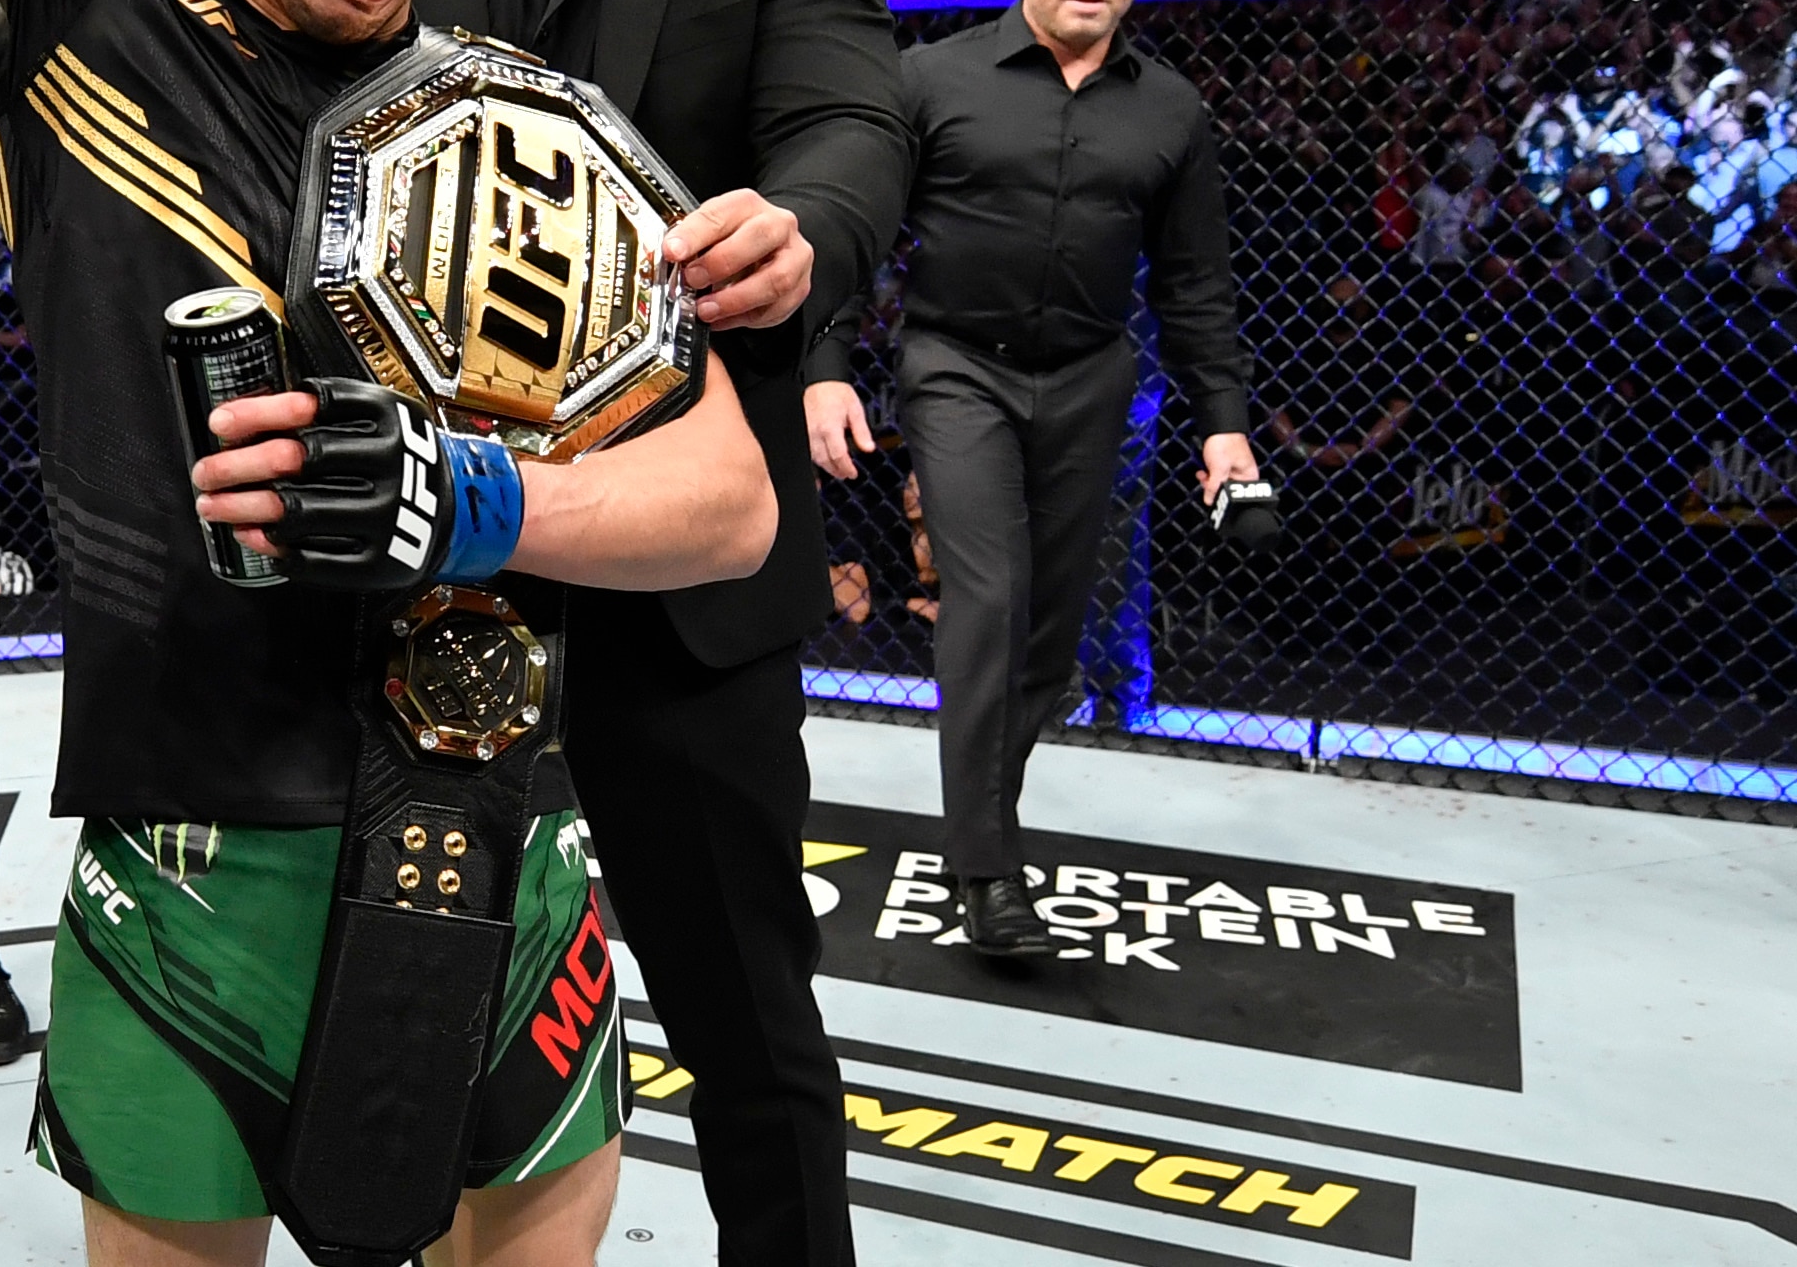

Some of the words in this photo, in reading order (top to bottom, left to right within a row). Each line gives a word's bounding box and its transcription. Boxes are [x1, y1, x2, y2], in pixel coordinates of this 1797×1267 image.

[431, 166, 455, 280] WORD
[477, 121, 575, 371] UFC
[387, 402, 438, 570] UFC
[78, 848, 136, 926] UFC
[884, 878, 1396, 960] POTEIN
[531, 910, 611, 1079] MO
[843, 1093, 1361, 1228] MATCH
